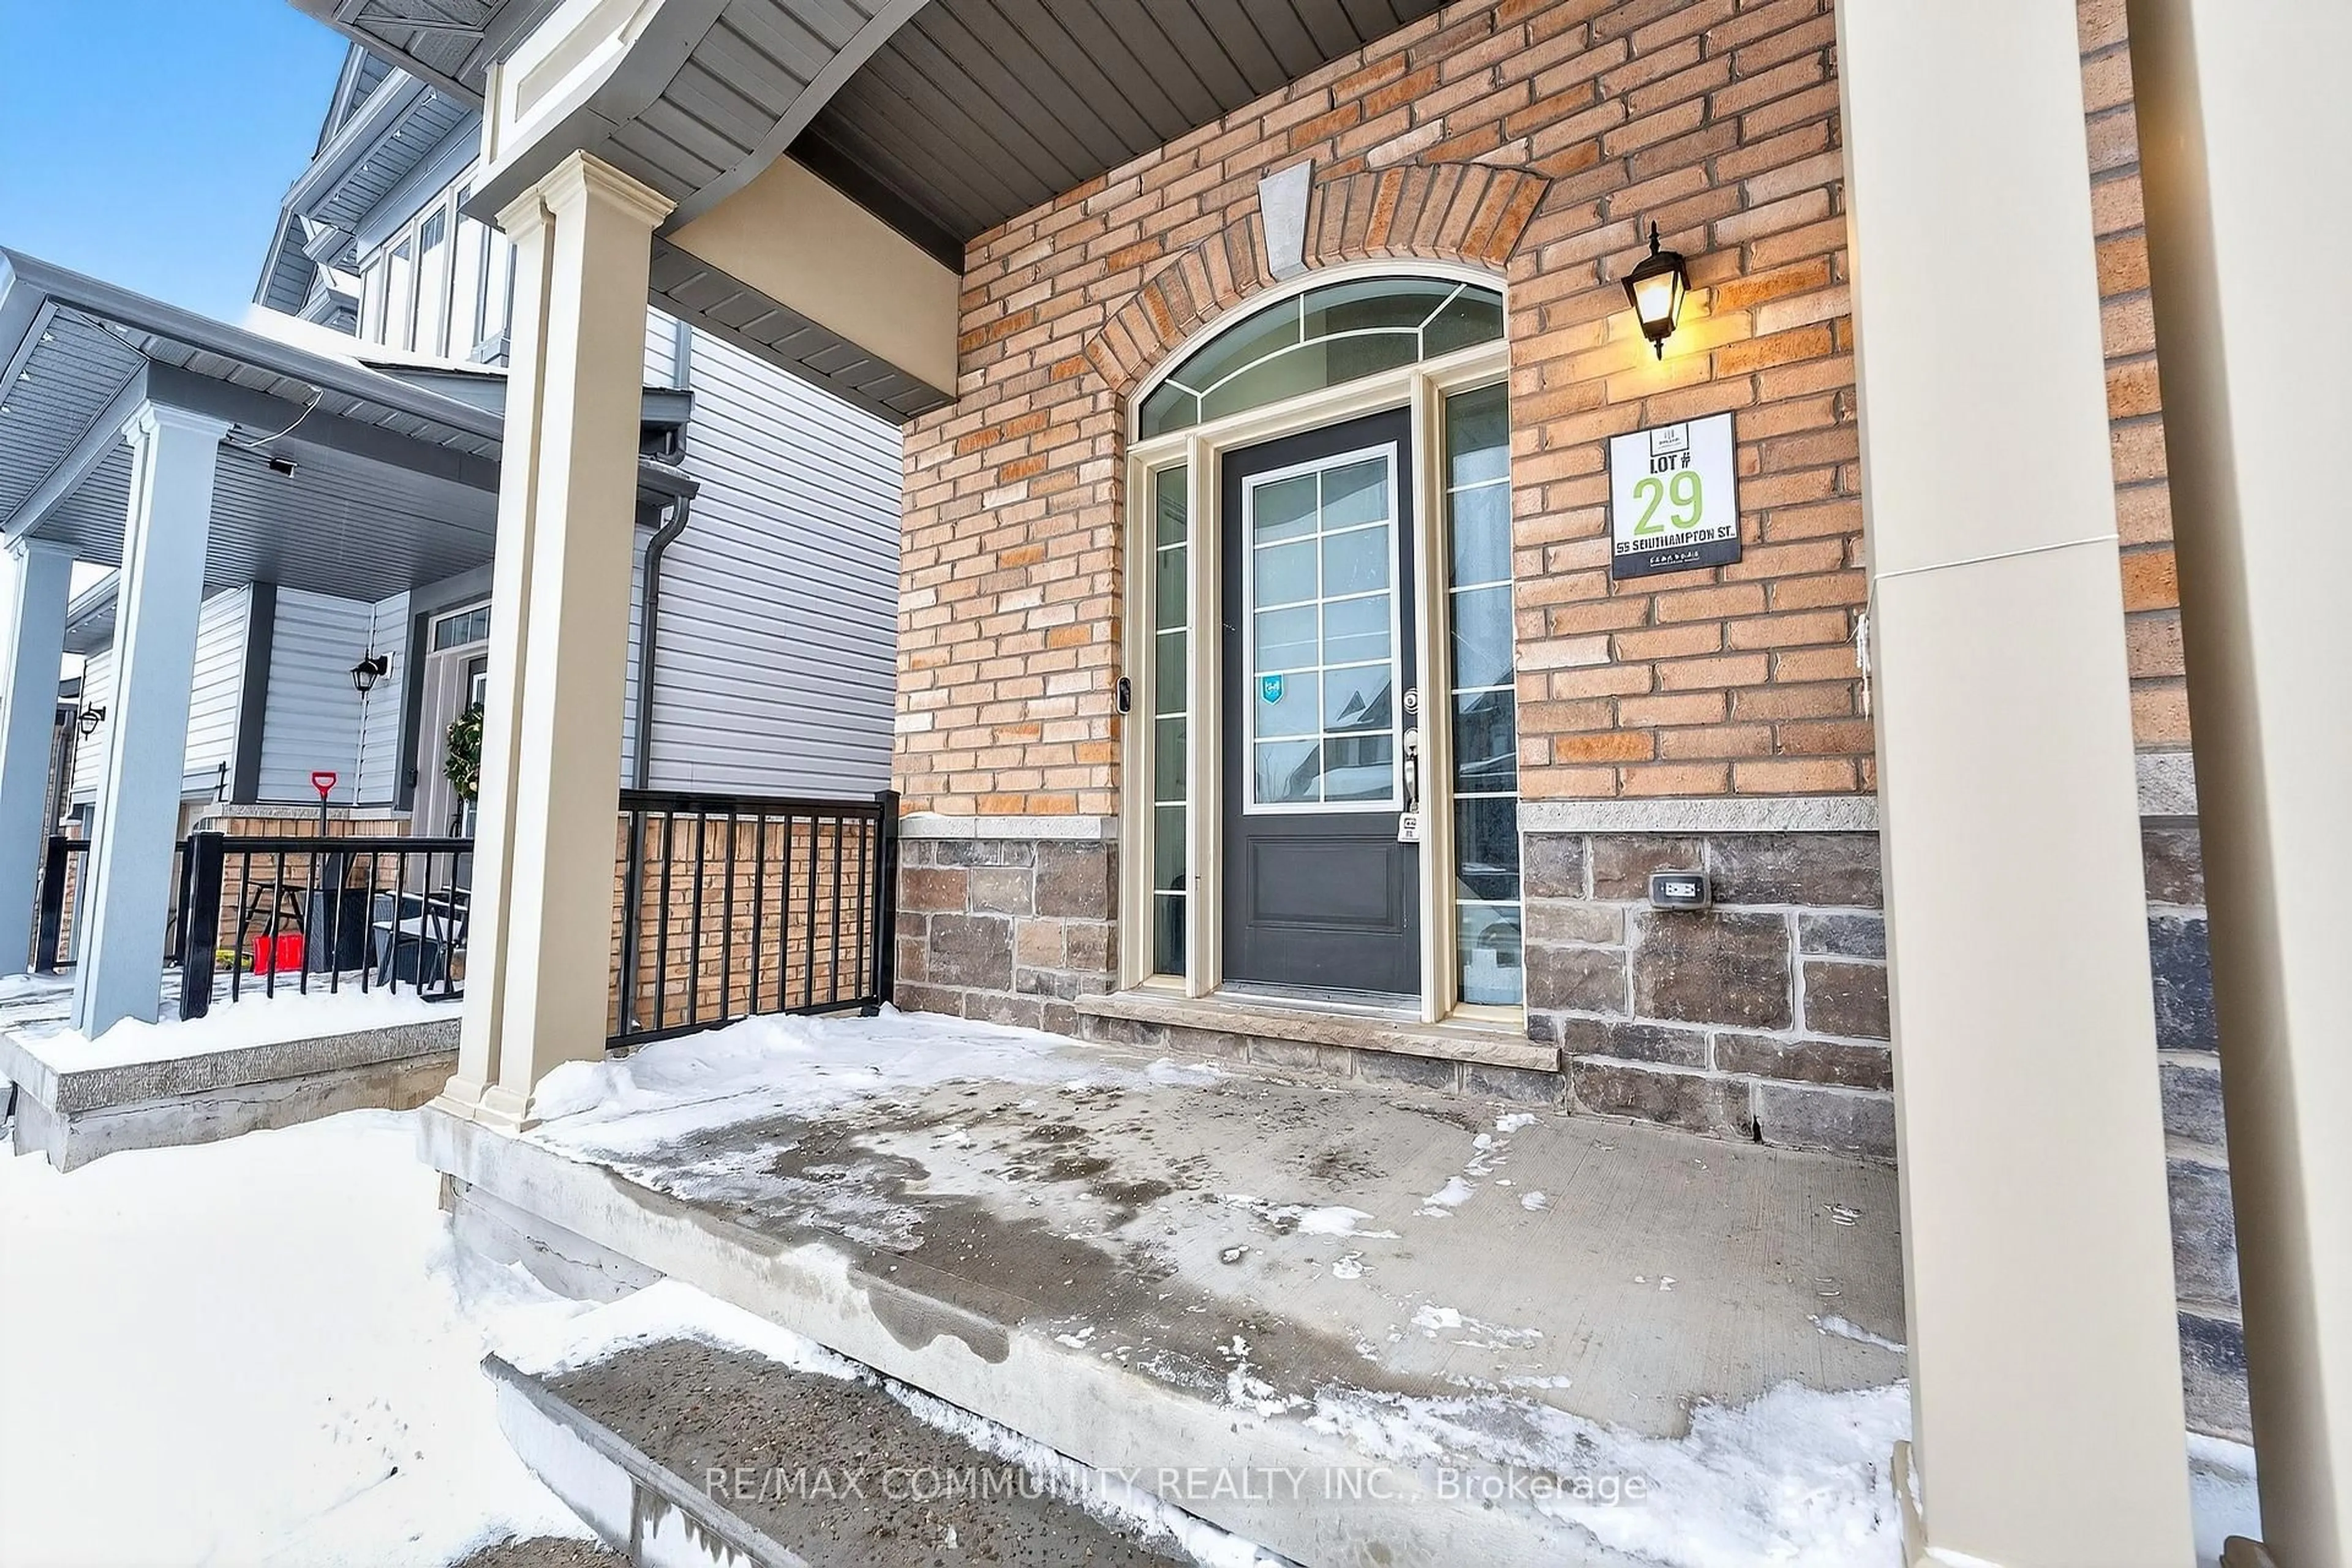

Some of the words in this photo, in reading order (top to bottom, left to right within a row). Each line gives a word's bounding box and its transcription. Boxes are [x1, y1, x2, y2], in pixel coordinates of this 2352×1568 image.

[1650, 454, 1678, 474] LOT
[1681, 452, 1691, 469] #
[1633, 470, 1703, 535] 29
